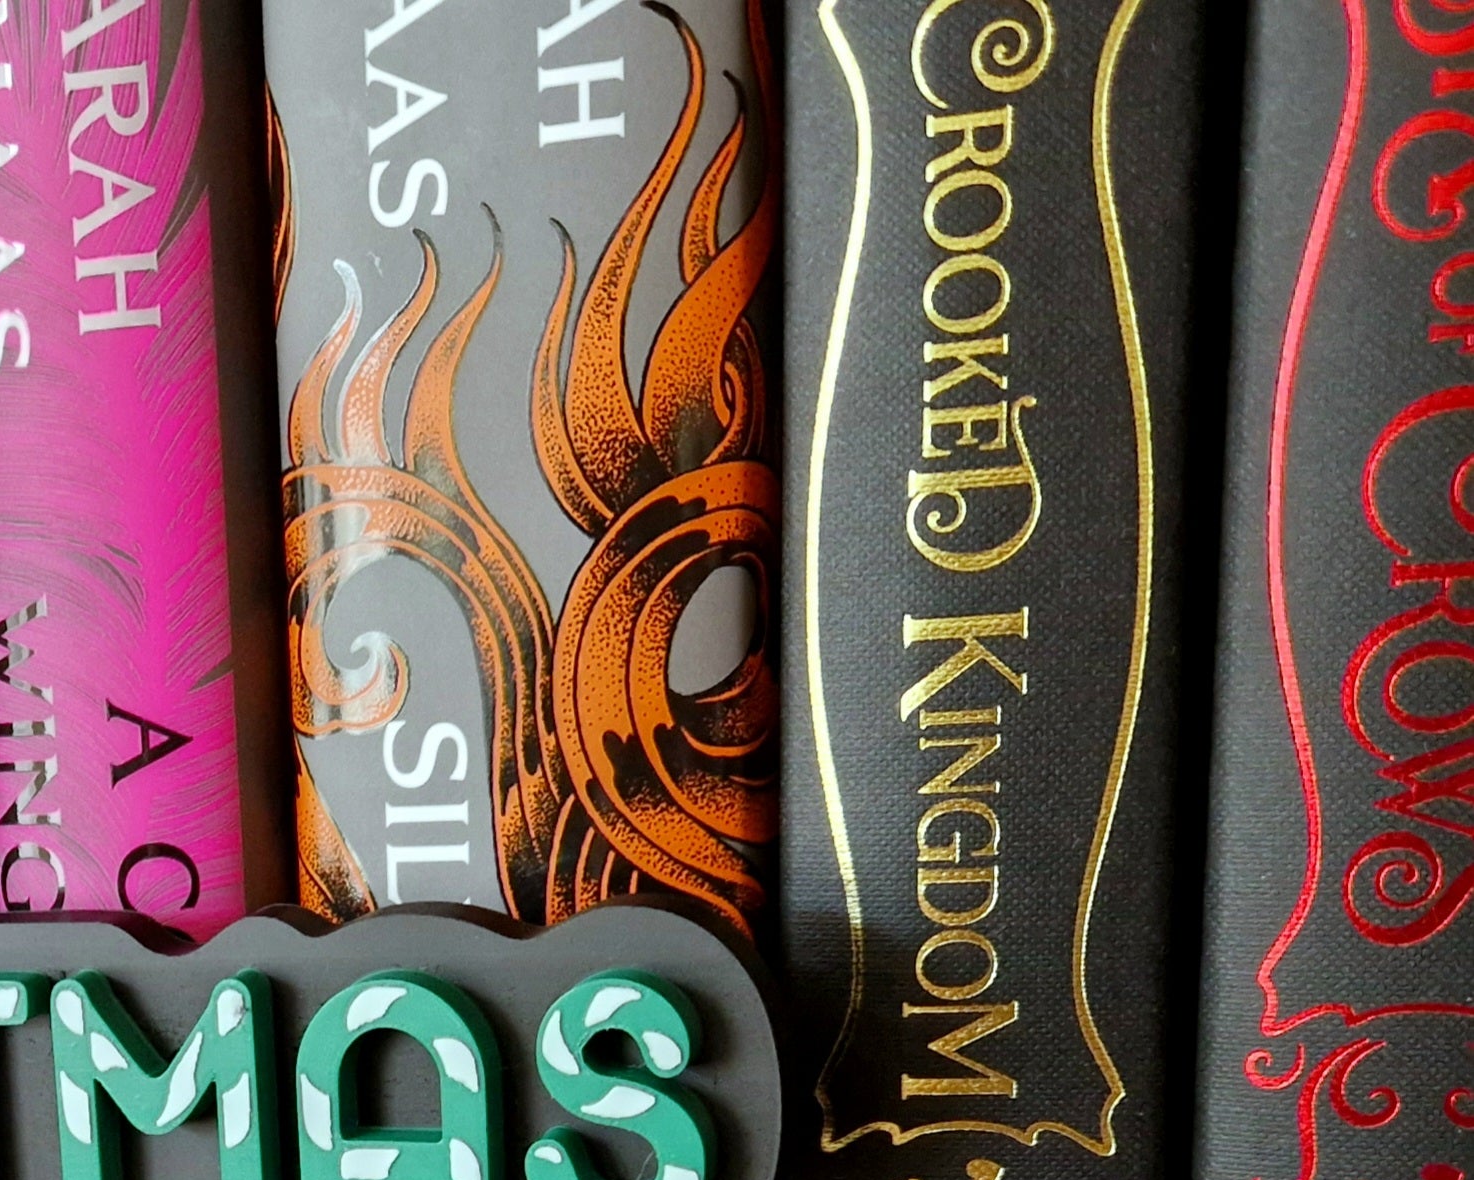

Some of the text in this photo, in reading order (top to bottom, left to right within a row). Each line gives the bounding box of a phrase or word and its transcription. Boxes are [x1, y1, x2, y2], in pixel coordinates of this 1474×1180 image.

[899, 0, 1058, 1101] CROOKED KINGDOM
[104, 697, 193, 790] A
[382, 719, 471, 906] SIL
